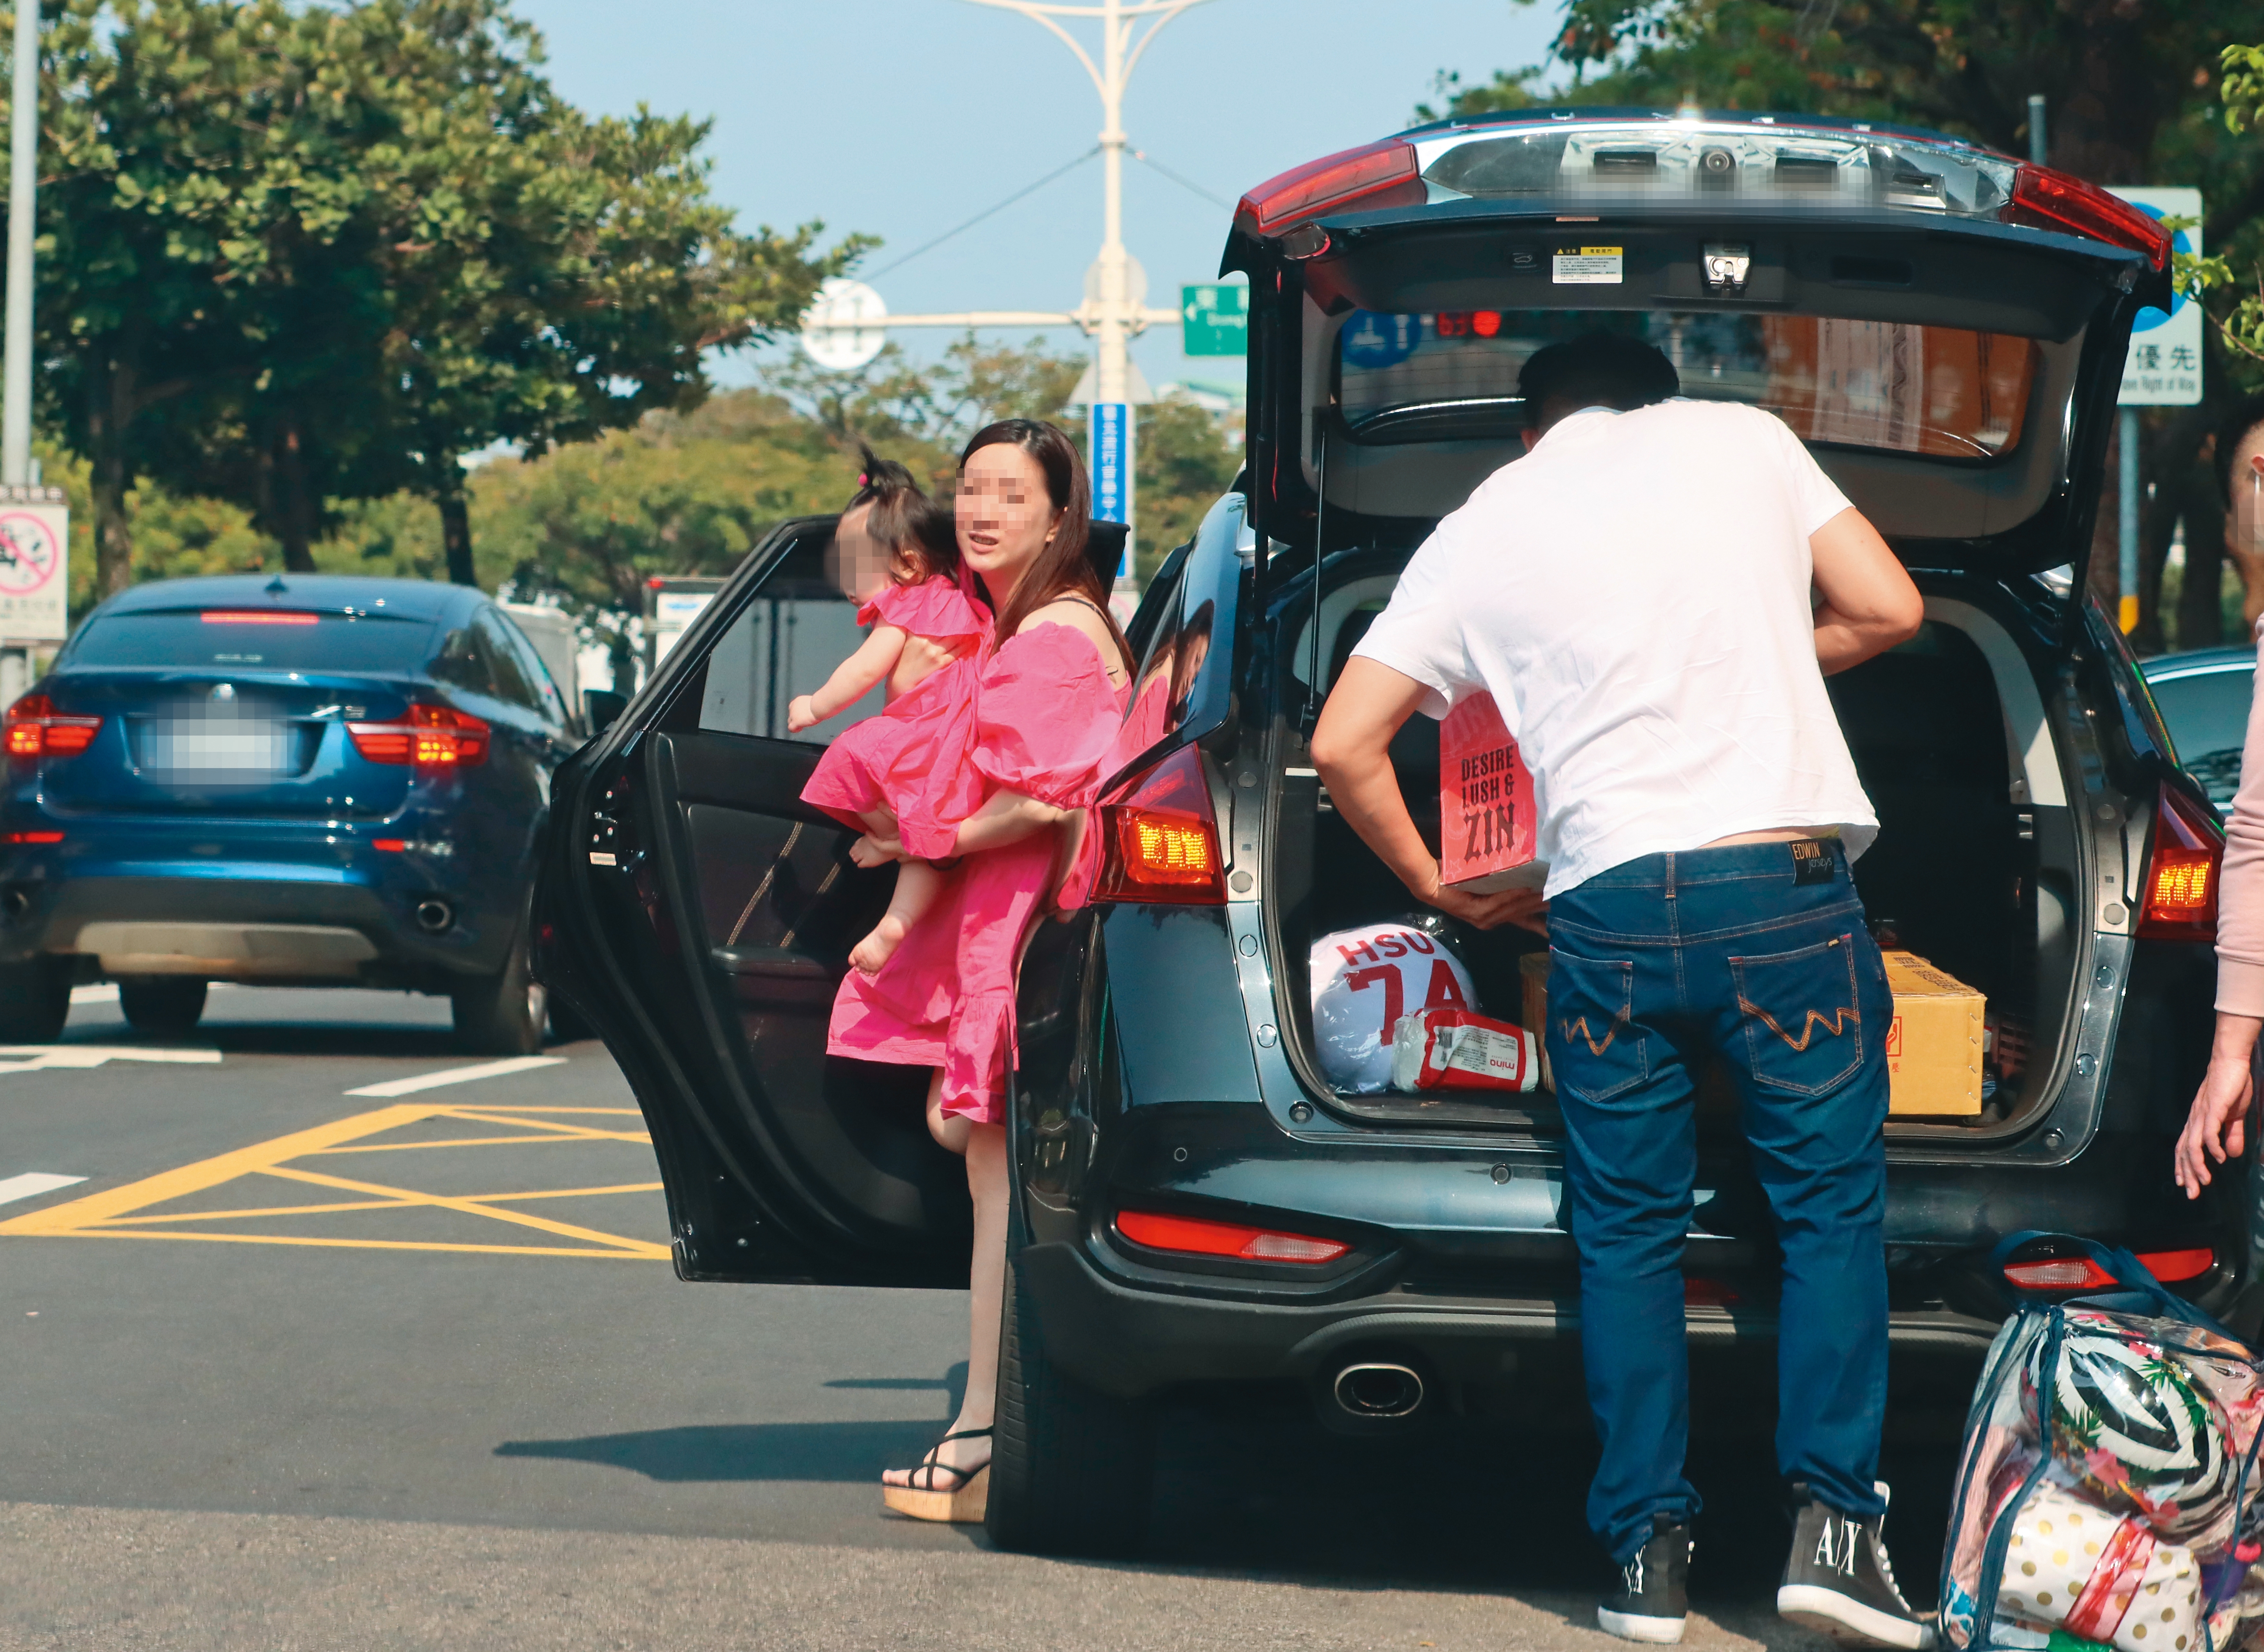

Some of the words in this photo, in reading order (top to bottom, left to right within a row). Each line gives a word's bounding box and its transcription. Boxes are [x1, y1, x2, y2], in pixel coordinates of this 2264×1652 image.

[2136, 343, 2196, 371] 優先
[1461, 745, 1515, 781] DESIRE
[1462, 776, 1500, 808] LUSH
[1504, 773, 1515, 797] &
[1463, 800, 1515, 866] ZIN
[1792, 842, 1821, 860] EDWIN
[1335, 931, 1435, 966] HSU
